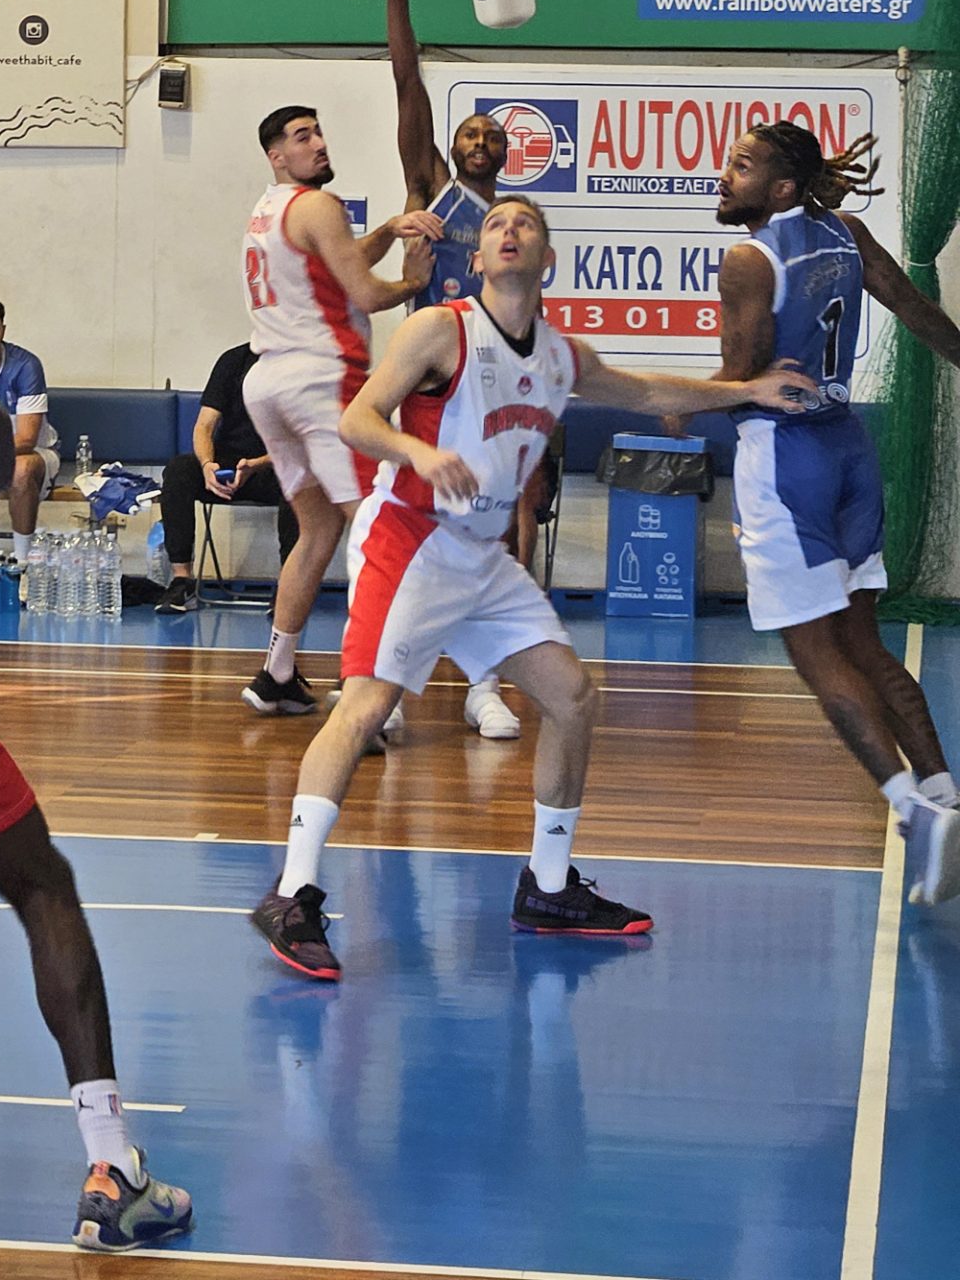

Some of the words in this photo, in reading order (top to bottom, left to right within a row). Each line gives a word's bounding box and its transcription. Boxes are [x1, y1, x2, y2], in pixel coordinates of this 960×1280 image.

[591, 177, 669, 193] ΤΕΧΝΙΚΟΣ
[574, 245, 662, 290] ΚΑΤΩ
[625, 306, 670, 330] 01
[695, 307, 717, 330] 8
[816, 296, 845, 381] 1
